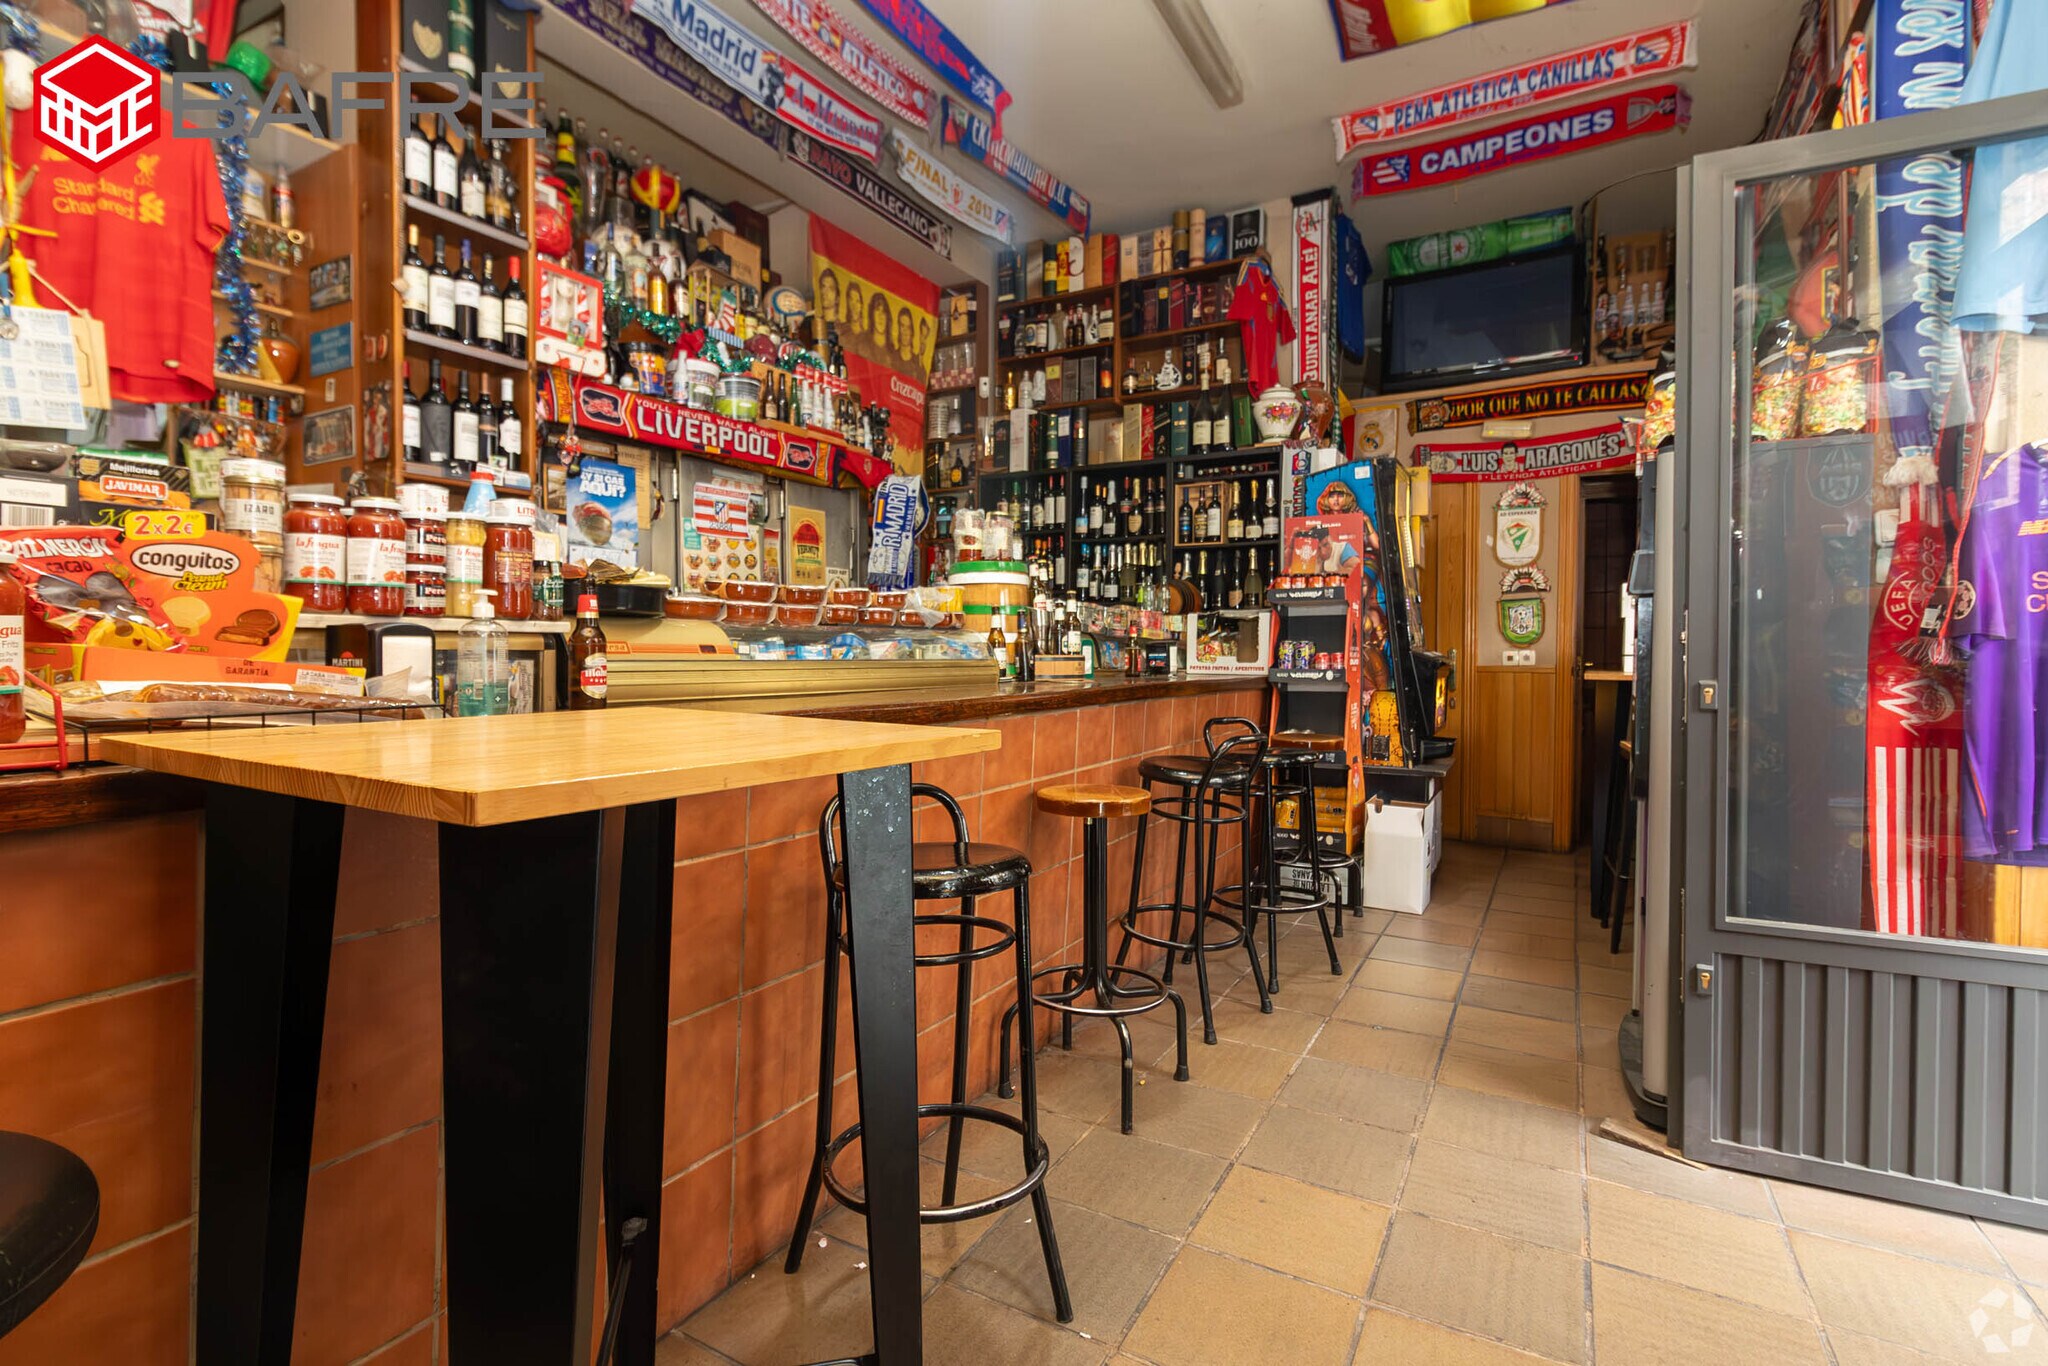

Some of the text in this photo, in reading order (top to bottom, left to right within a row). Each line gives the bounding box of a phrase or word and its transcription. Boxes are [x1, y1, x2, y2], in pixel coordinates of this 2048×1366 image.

[671, 0, 757, 75] Madrid
[1393, 95, 1435, 134] PEÑA
[1440, 71, 1521, 119] ATLÉTICA
[1526, 46, 1616, 94] CANILLAS
[1420, 109, 1615, 175] CAMPEONES
[904, 149, 948, 193] FINAL
[809, 142, 852, 186] RAYO
[856, 173, 929, 237] VALLECANO
[1234, 236, 1258, 250] 100
[1489, 397, 1520, 416] QUE
[1525, 391, 1549, 410] NO
[1555, 390, 1573, 406] TE
[636, 405, 777, 461] LIVERPOOL
[677, 409, 711, 423] NEVER
[716, 418, 744, 431] WALK
[748, 425, 777, 441] ALONE
[1461, 433, 1621, 473] LUIS ARAGONÉS
[109, 462, 160, 477] Mejillones
[1490, 472, 1536, 481] LEYENDA
[105, 478, 164, 498] JAVIMAR
[905, 496, 917, 533] WEMBLEY
[138, 551, 234, 572] conguitos
[182, 571, 225, 583] Peanut
[331, 658, 364, 668] MARTINI
